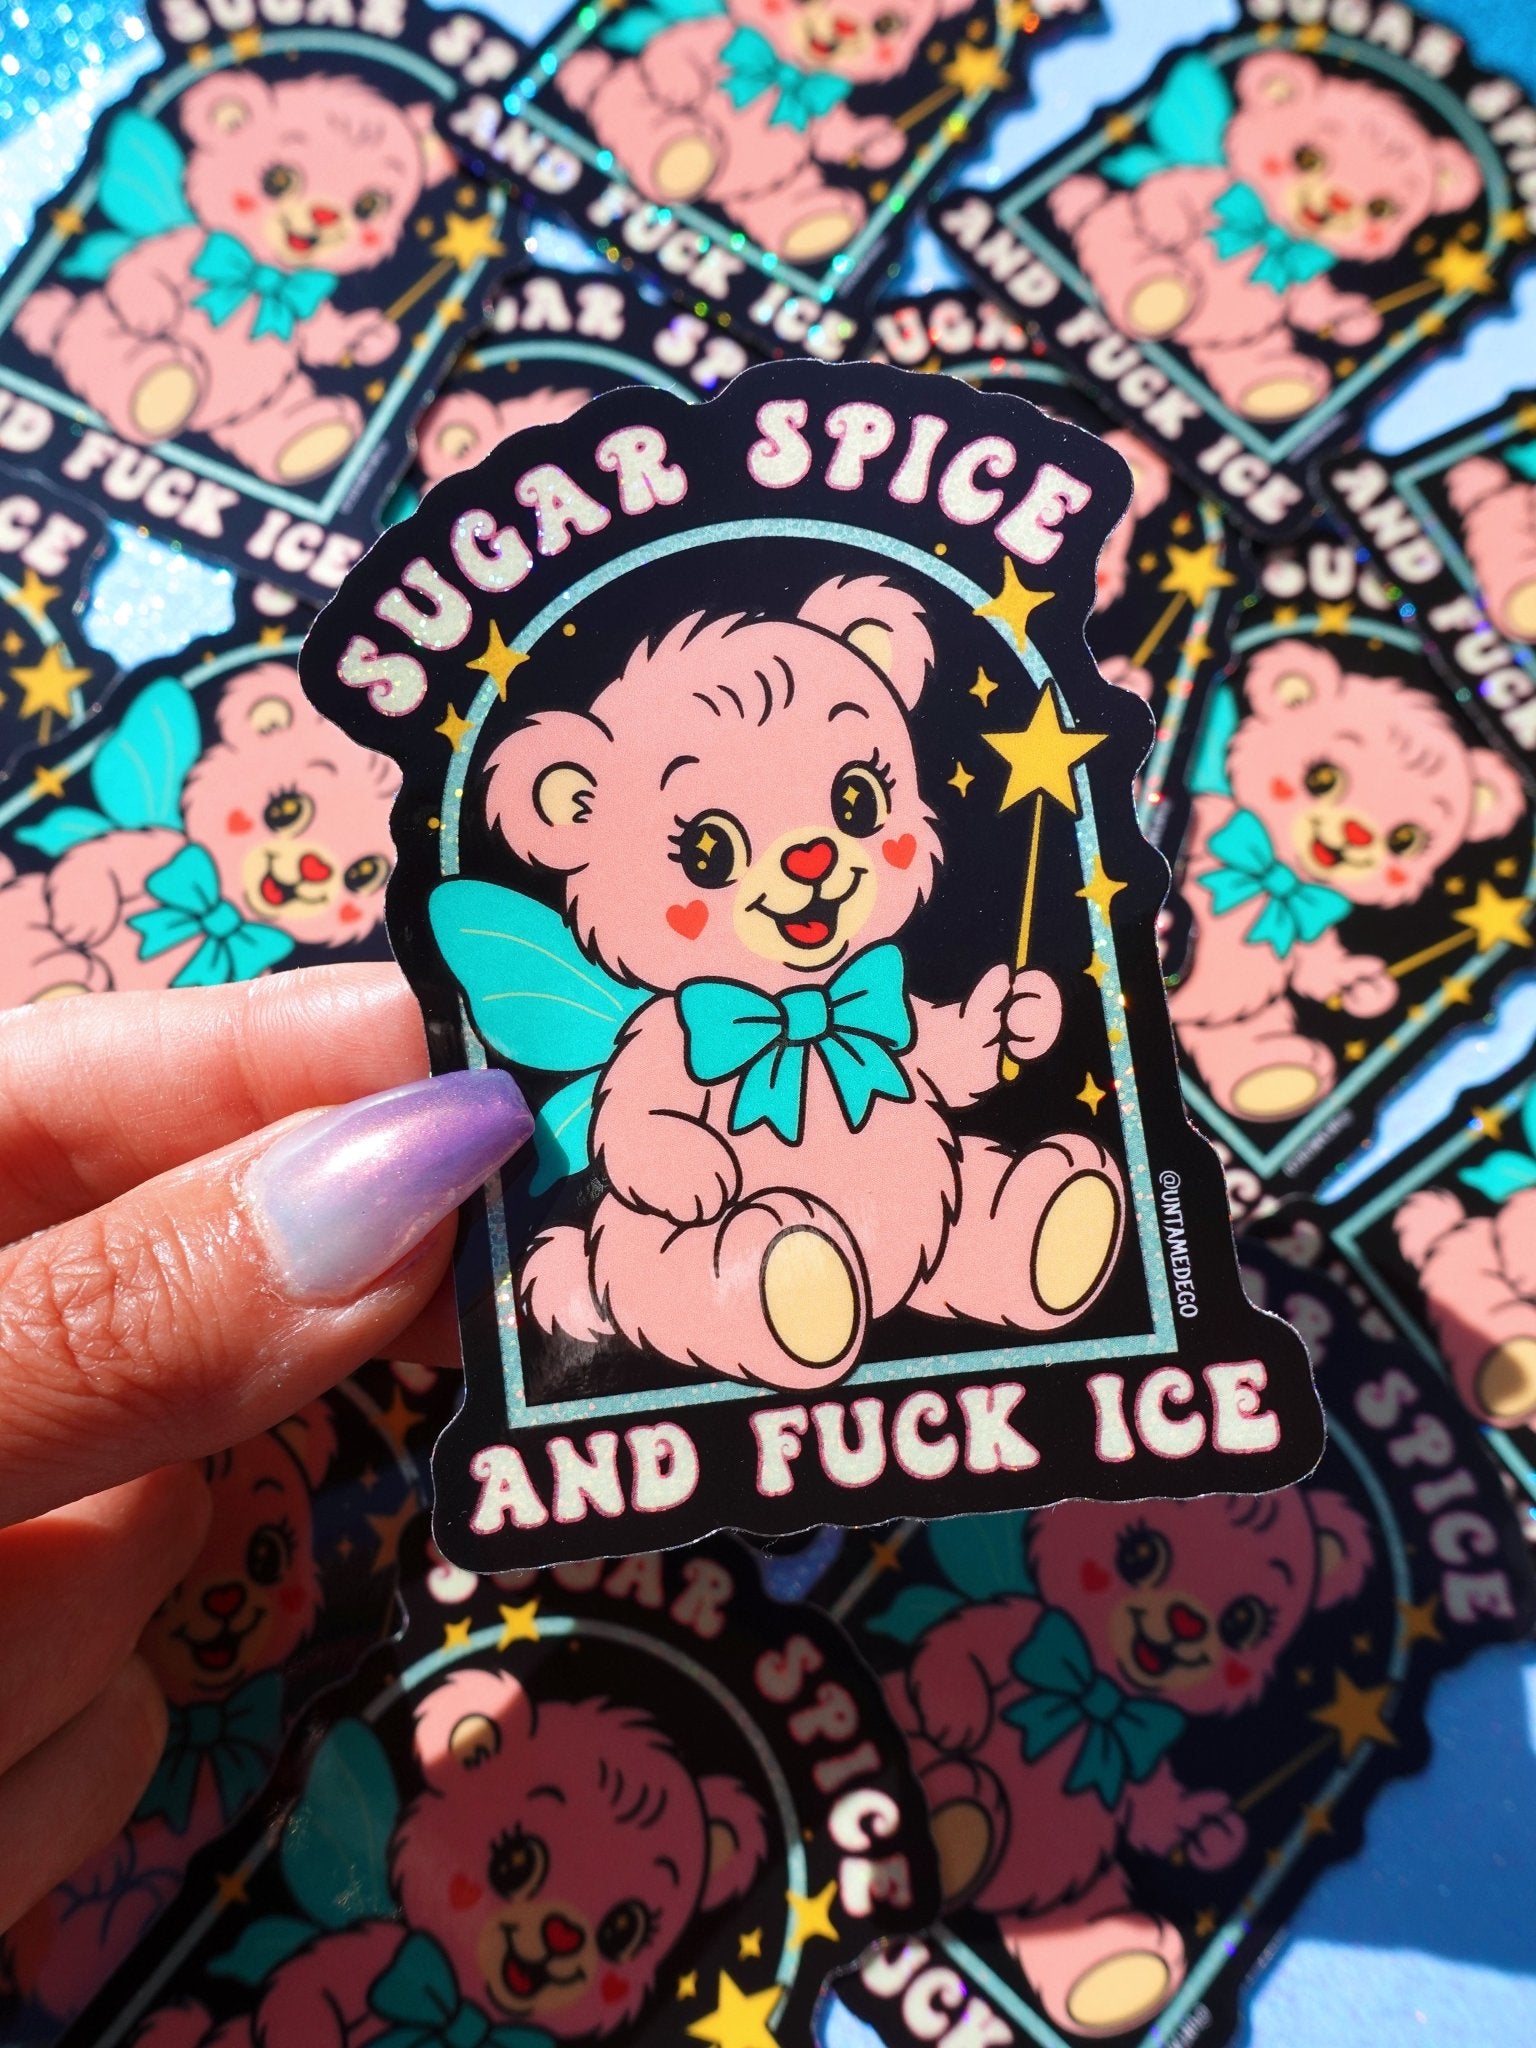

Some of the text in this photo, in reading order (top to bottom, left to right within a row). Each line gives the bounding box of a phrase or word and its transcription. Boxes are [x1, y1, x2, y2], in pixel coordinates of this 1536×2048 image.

[448, 95, 582, 194] AND
[586, 184, 744, 299] FUCK
[748, 281, 857, 361] ICE
[940, 198, 1061, 307] AND
[1055, 307, 1202, 440] FUCK
[1197, 434, 1303, 524] ICE
[61, 431, 240, 538] FUCK
[245, 508, 364, 589] ICE
[336, 400, 1093, 718] SUGAR SPICE
[1332, 461, 1443, 584] AND
[1158, 1170, 1199, 1319] @UNTAMEDEGO
[469, 1360, 1280, 1536] AND FUCK ICE
[1354, 1366, 1517, 1624] SPICE
[754, 1634, 913, 1919] SPICE
